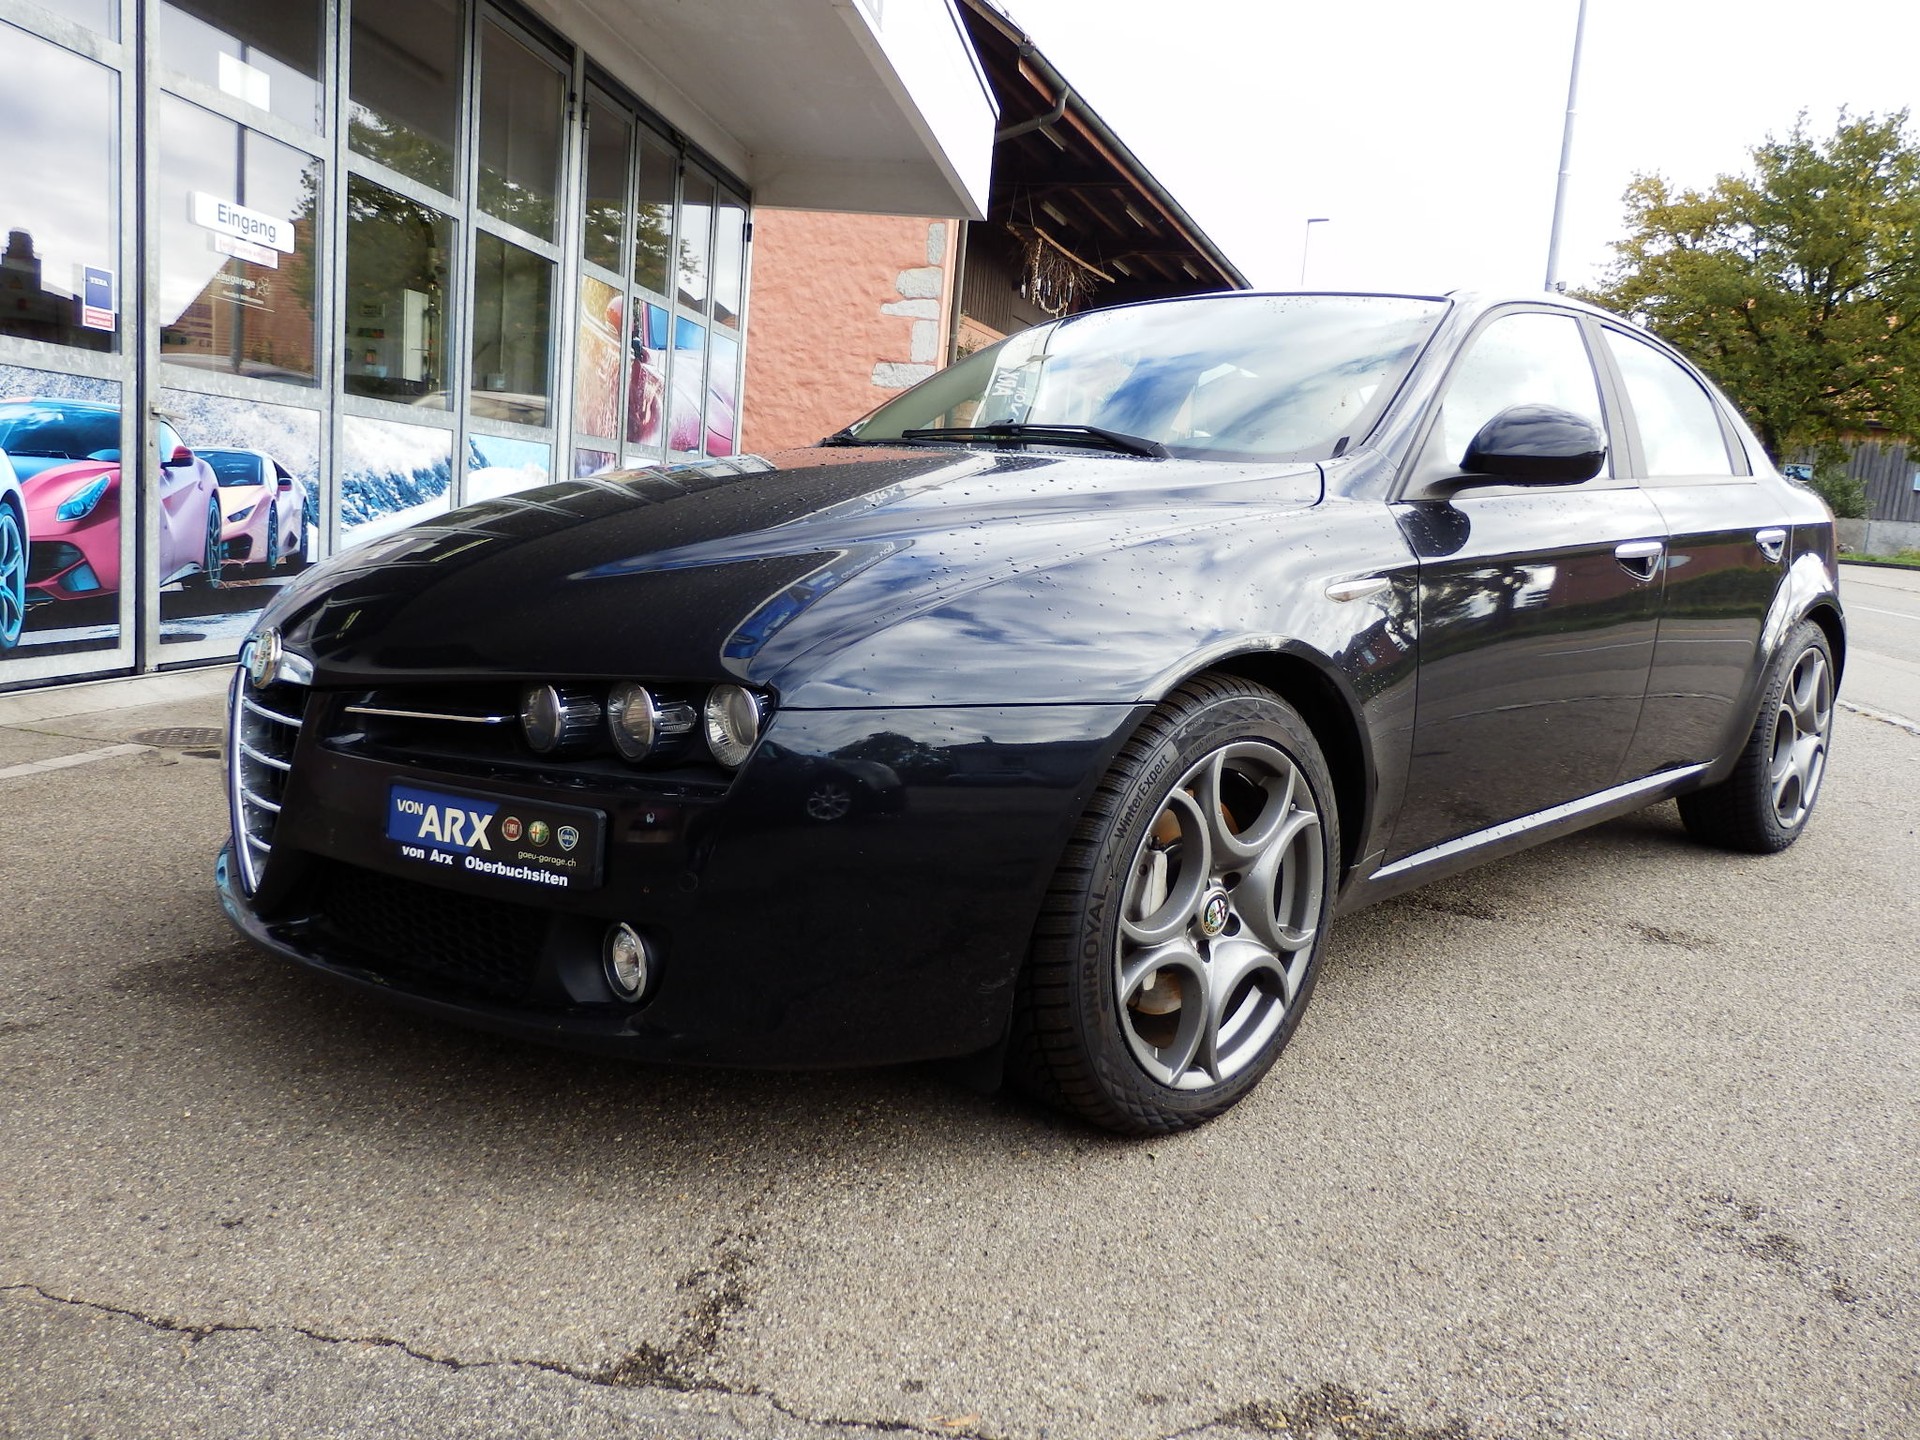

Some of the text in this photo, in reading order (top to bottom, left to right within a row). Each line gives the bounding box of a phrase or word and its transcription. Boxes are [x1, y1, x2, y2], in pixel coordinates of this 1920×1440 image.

[217, 203, 276, 243] Eingang
[1114, 753, 1170, 840] WinterExpert
[397, 798, 424, 816] VON
[418, 804, 493, 851] ARX
[402, 845, 569, 887] von Arx Oberbuchsiten
